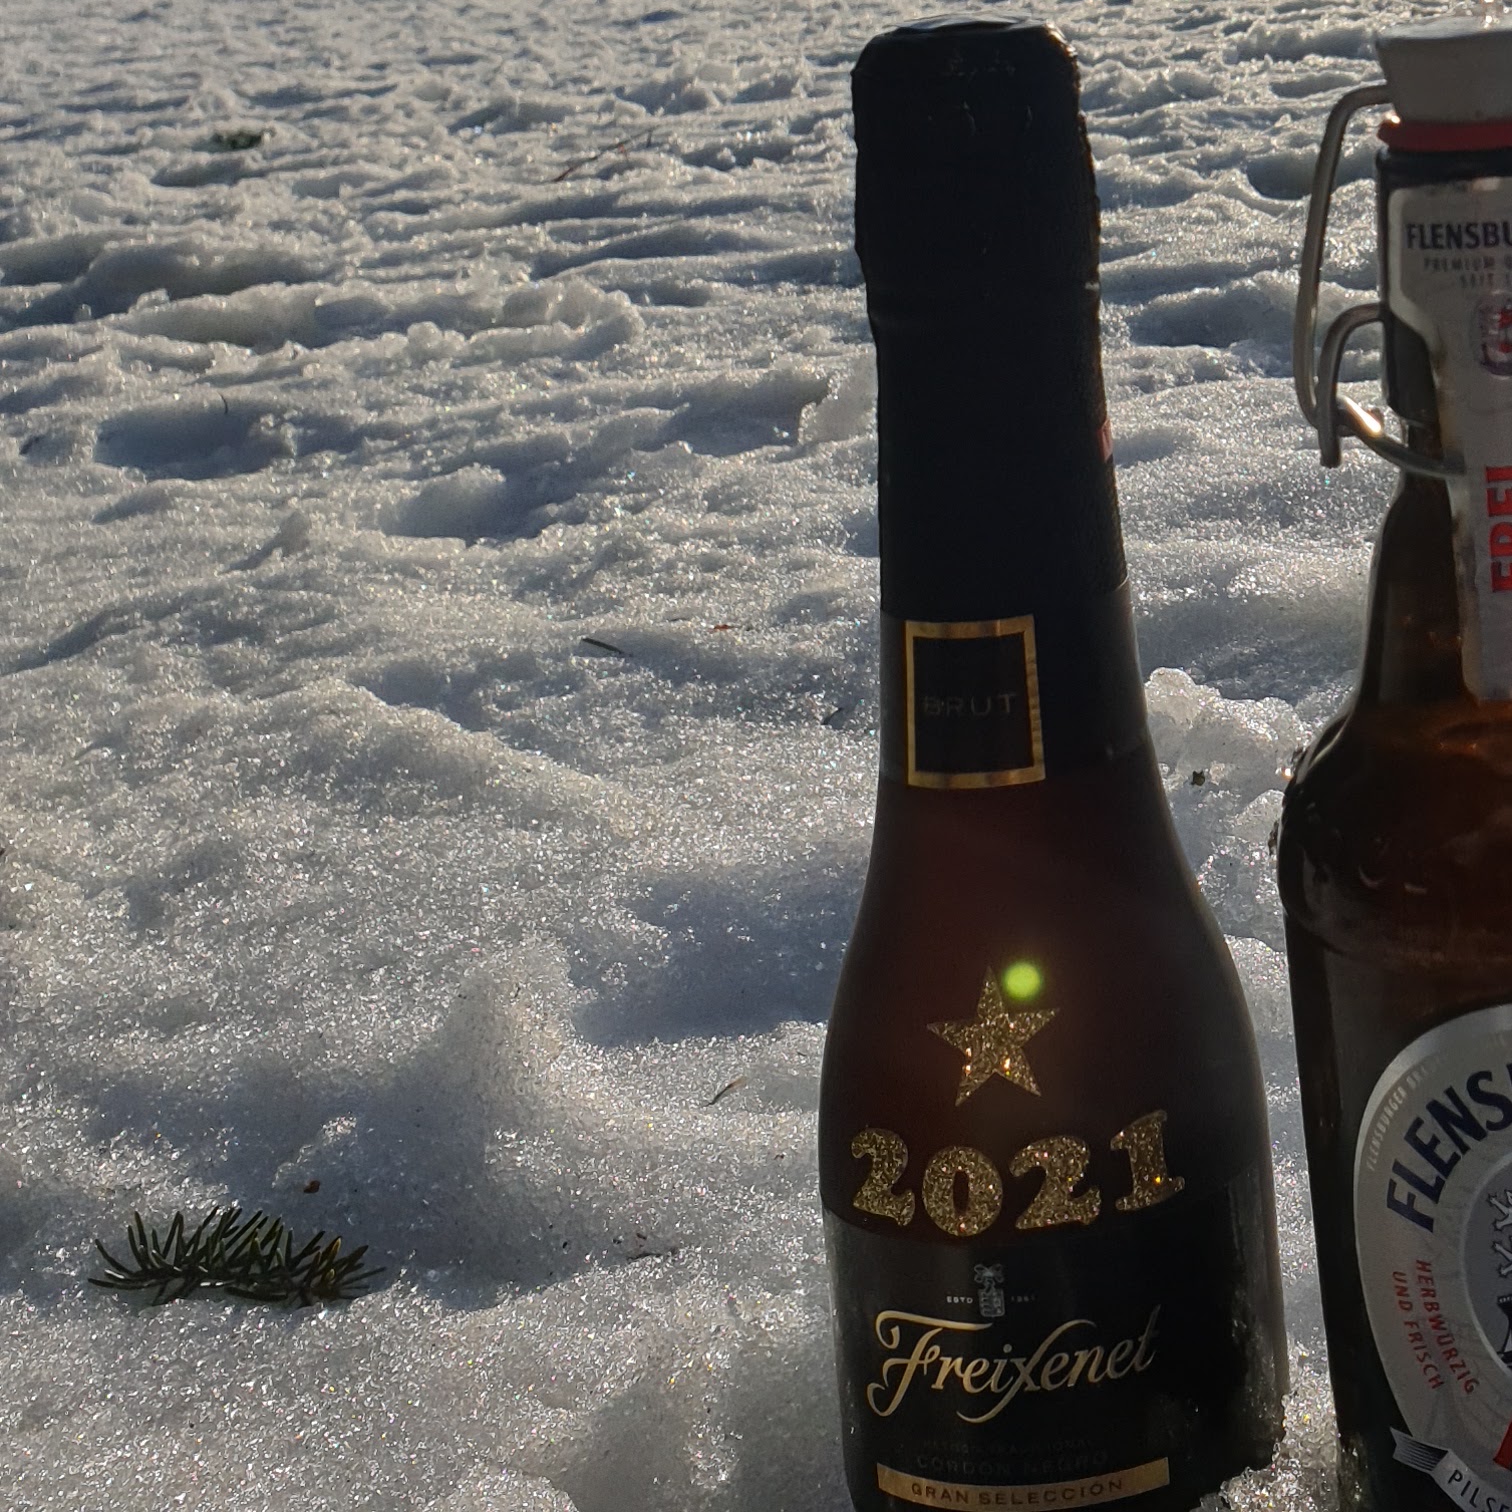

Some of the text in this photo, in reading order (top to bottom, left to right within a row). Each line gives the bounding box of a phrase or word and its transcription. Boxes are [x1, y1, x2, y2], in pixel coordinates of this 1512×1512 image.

[922, 693, 1017, 717] BRUT
[851, 1109, 1185, 1237] 2021
[867, 1304, 1162, 1424] Freixenet
[1392, 1271, 1445, 1389] UND FRISCH
[1416, 1259, 1480, 1395] HERBWÜRZIG
[910, 1482, 970, 1506] GRAN
